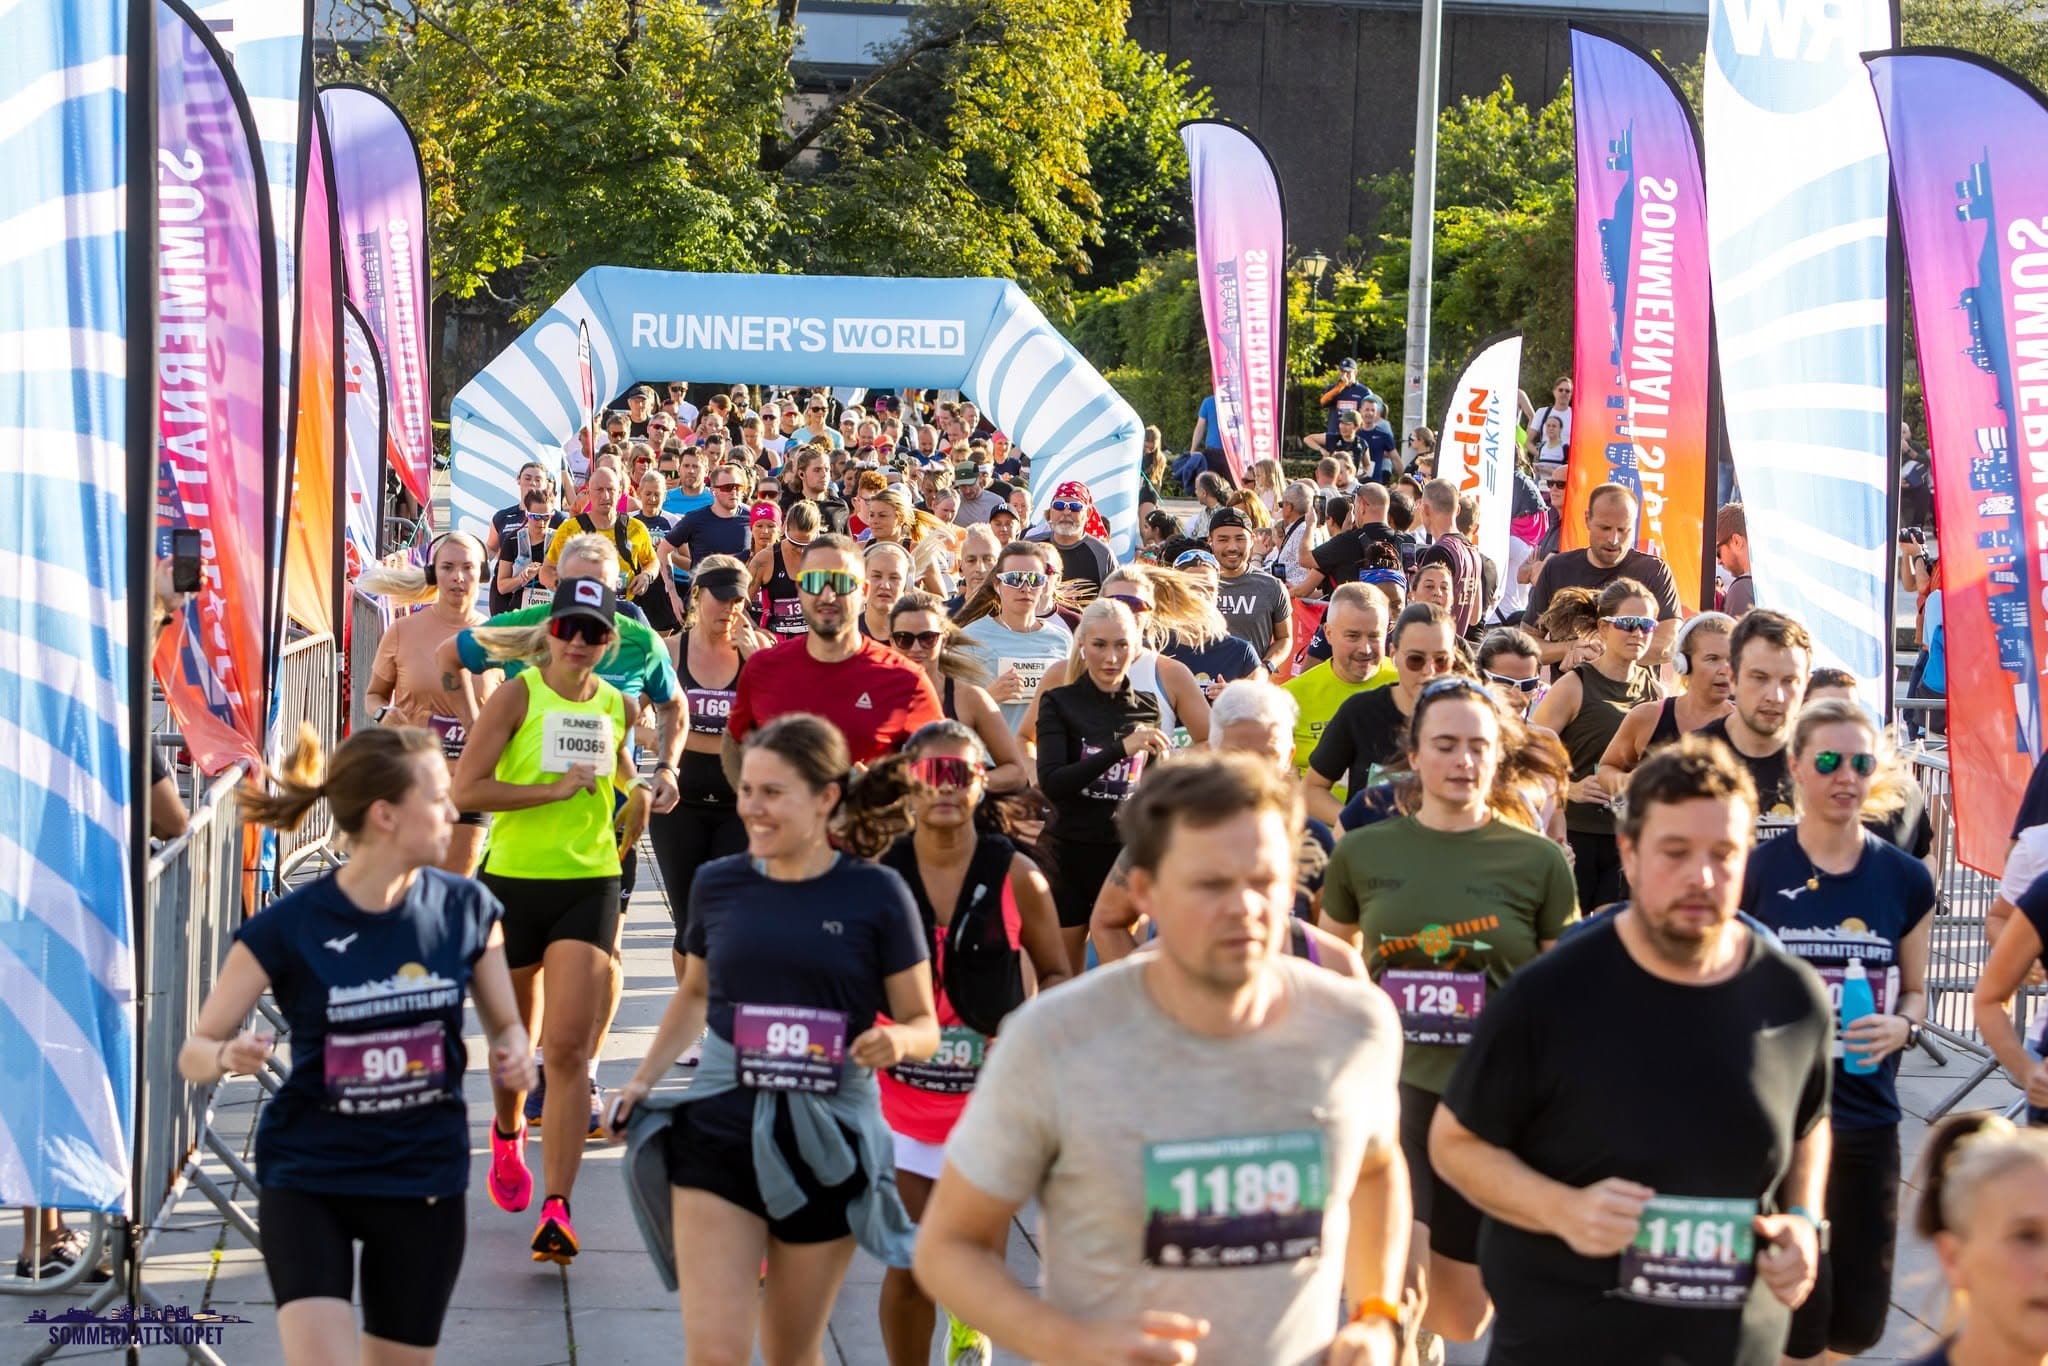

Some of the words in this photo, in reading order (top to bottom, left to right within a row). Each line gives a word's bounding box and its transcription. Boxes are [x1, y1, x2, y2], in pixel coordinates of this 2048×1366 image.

[632, 312, 826, 352] RUNNER'S
[838, 323, 960, 348] WORLD
[695, 698, 731, 717] 169
[558, 737, 605, 754] 100369
[1098, 762, 1131, 782] 91
[1402, 983, 1459, 1016] 129
[765, 1021, 810, 1058] 99
[928, 1040, 973, 1067] 59
[361, 1045, 408, 1081] 90
[1170, 1159, 1301, 1222] 1189
[1645, 1217, 1736, 1265] 1161
